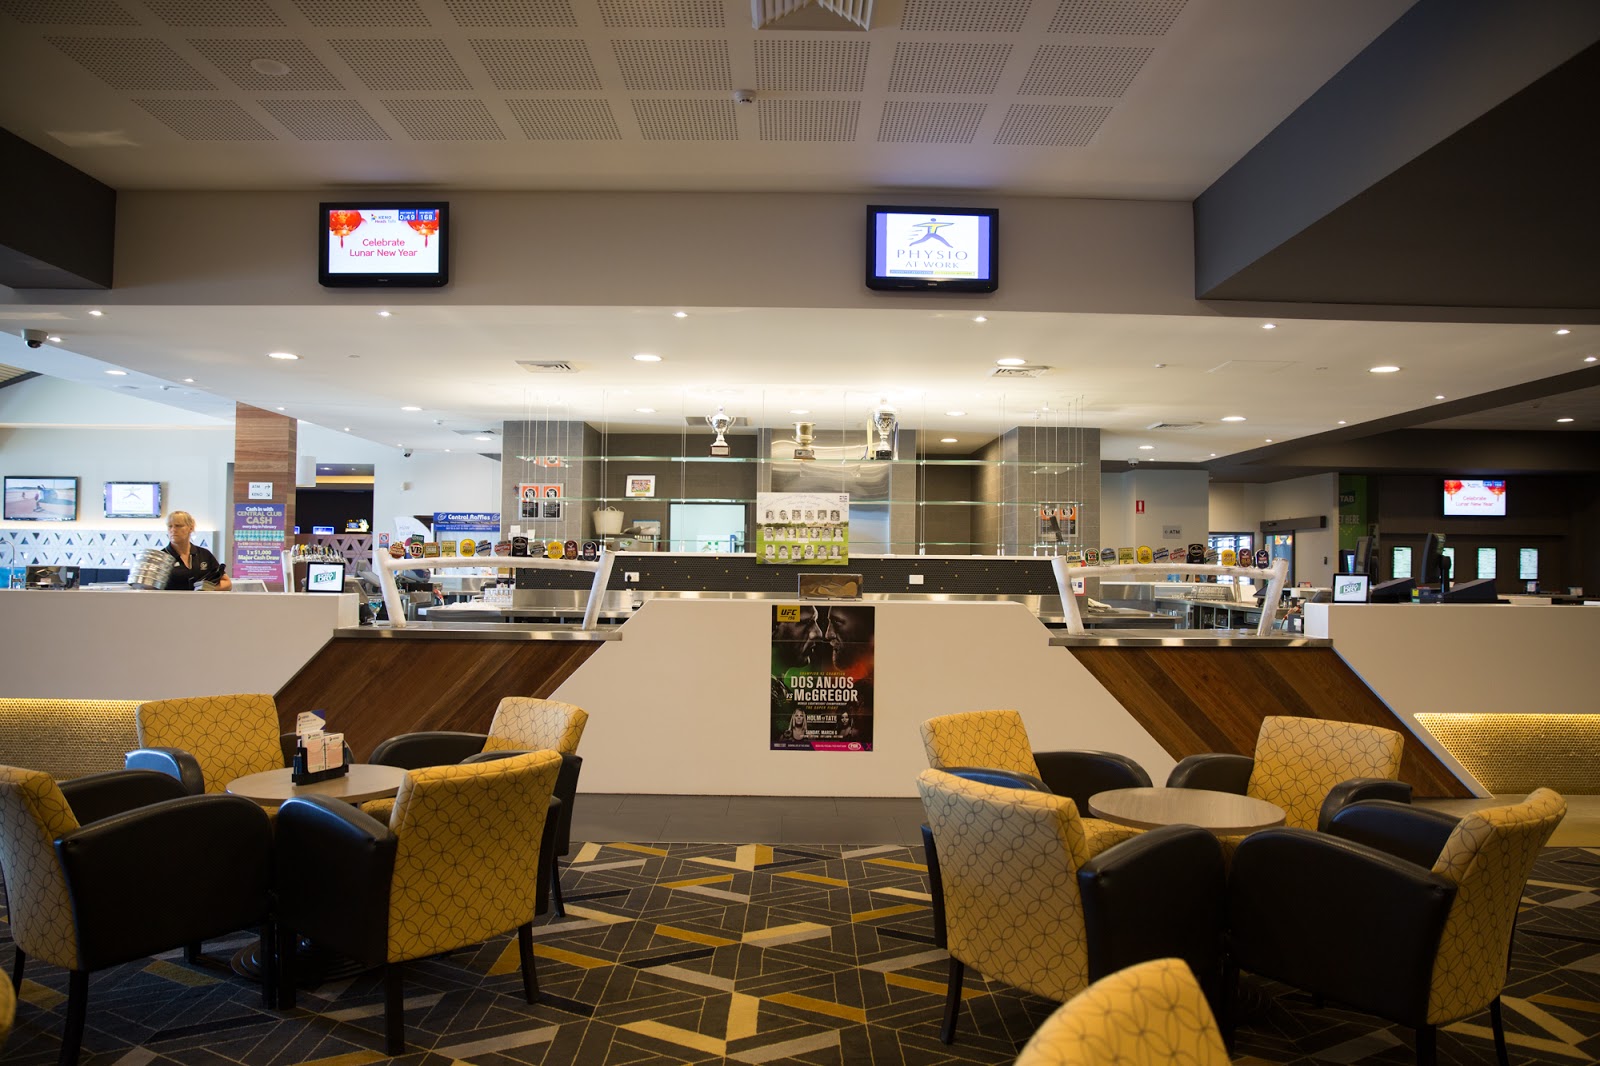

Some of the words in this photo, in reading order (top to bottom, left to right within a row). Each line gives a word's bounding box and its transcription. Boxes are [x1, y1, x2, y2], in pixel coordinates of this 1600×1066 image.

[362, 238, 405, 246] Celebrate
[350, 248, 374, 257] Lunar
[897, 249, 968, 260] PHYSIO
[1345, 515, 1360, 524] HERE
[791, 676, 813, 688] DOS
[816, 676, 854, 689] ANJOS
[794, 689, 858, 702] McGREGOR
